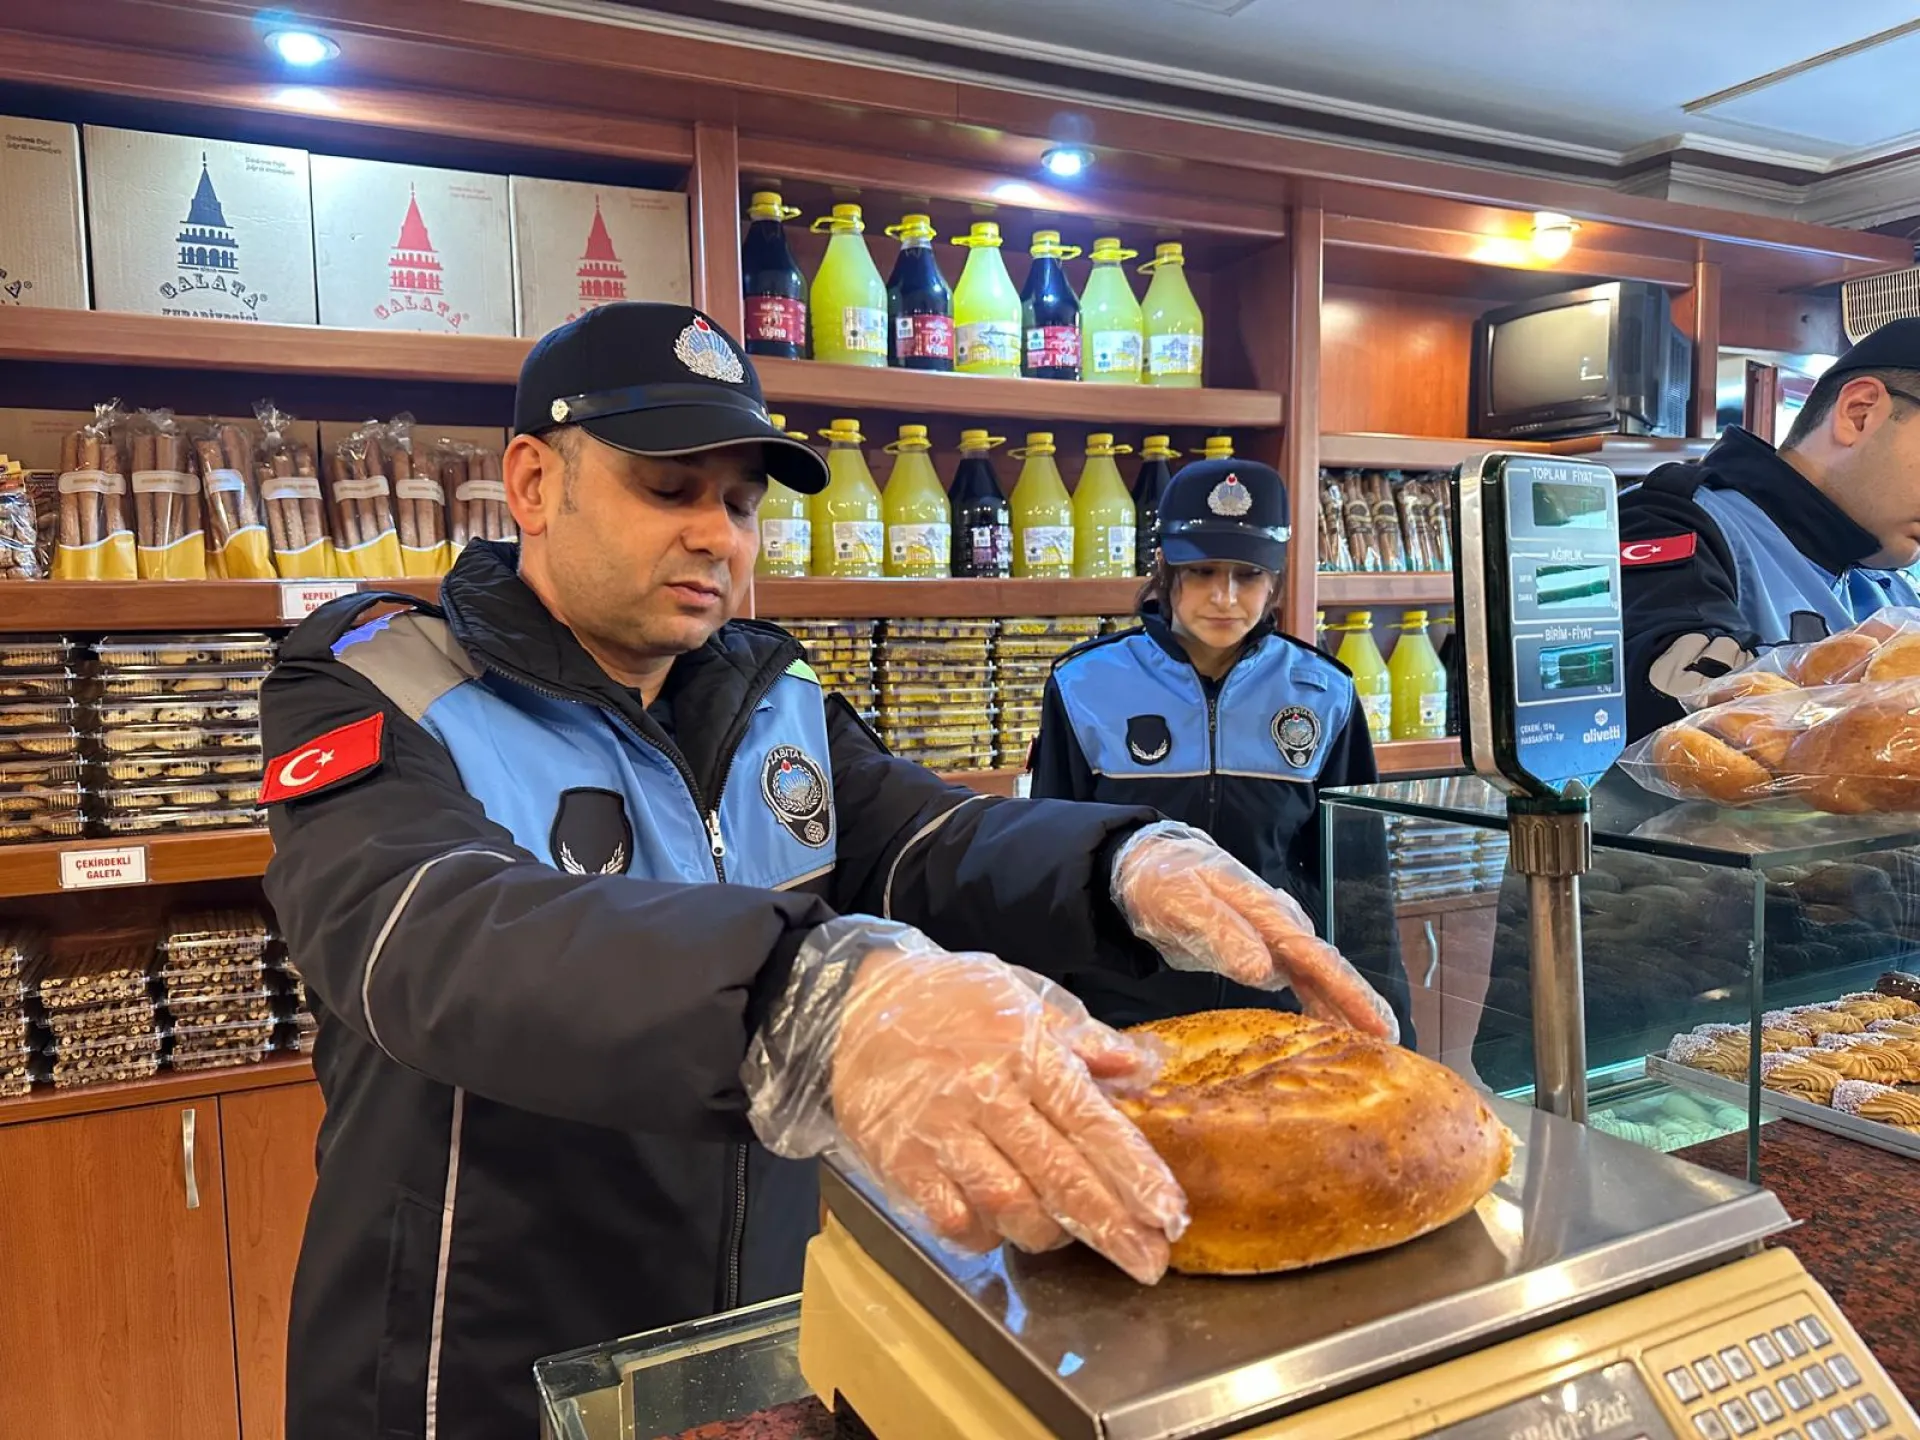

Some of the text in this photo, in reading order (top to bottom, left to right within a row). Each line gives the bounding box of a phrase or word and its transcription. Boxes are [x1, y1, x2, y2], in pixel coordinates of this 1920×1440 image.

[159, 273, 259, 310] GALATA
[374, 295, 462, 329] GALATA
[1531, 466, 1593, 483] TOPLAM FİYAT
[1550, 547, 1582, 561] AĞIRLIK
[302, 589, 337, 600] KEPEKLİ
[1583, 724, 1620, 744] olivetti
[768, 748, 800, 766] ZABITA
[75, 854, 132, 870] ÇEKİRDEKLİ
[86, 869, 122, 880] GALETA
